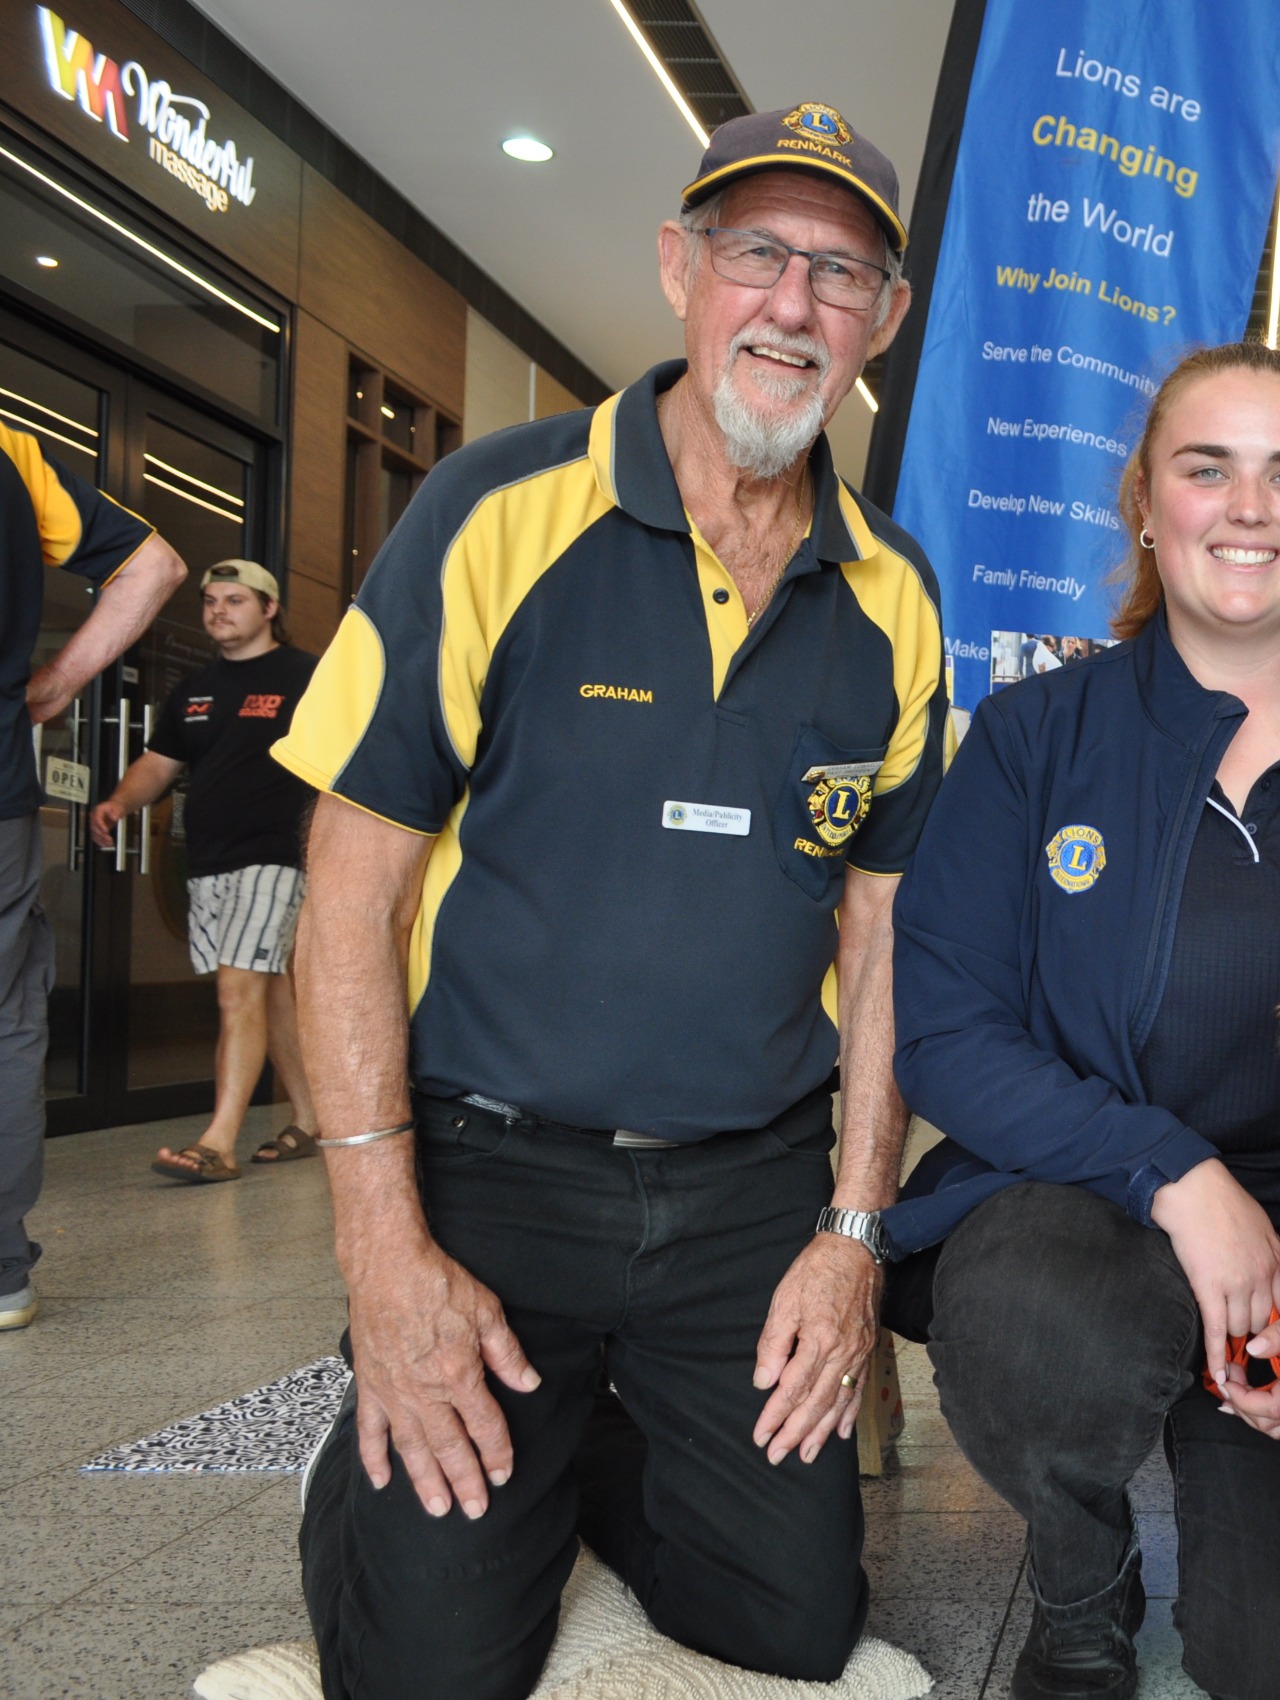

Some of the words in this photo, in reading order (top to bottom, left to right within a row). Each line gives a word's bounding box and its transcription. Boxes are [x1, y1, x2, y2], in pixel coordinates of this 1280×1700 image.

[1056, 47, 1141, 97] Lions
[1149, 85, 1201, 122] are
[121, 61, 256, 206] Wonderful
[777, 139, 852, 168] RENMARK
[1032, 115, 1198, 198] Changing
[150, 136, 229, 213] massage
[1027, 192, 1070, 223] the
[1083, 197, 1174, 257] World
[996, 265, 1041, 294] Why
[1043, 268, 1091, 295] Join
[1098, 280, 1177, 326] Lions?
[982, 341, 1028, 362] Serve
[1030, 344, 1052, 363] the
[1057, 346, 1161, 398] Community
[986, 416, 1021, 437] New
[1023, 418, 1128, 458] Experiences
[968, 489, 1026, 516] Develop
[1028, 494, 1065, 516] New
[1069, 500, 1120, 531] Skills
[972, 564, 1017, 591] Family
[1019, 569, 1086, 601] Friendly
[944, 637, 989, 661] Make
[580, 684, 653, 703] GRAHAM
[52, 769, 84, 790] OPEN
[705, 818, 728, 829] Officer
[832, 789, 850, 820] L
[1065, 828, 1099, 843] LIONS
[1068, 845, 1087, 871] L
